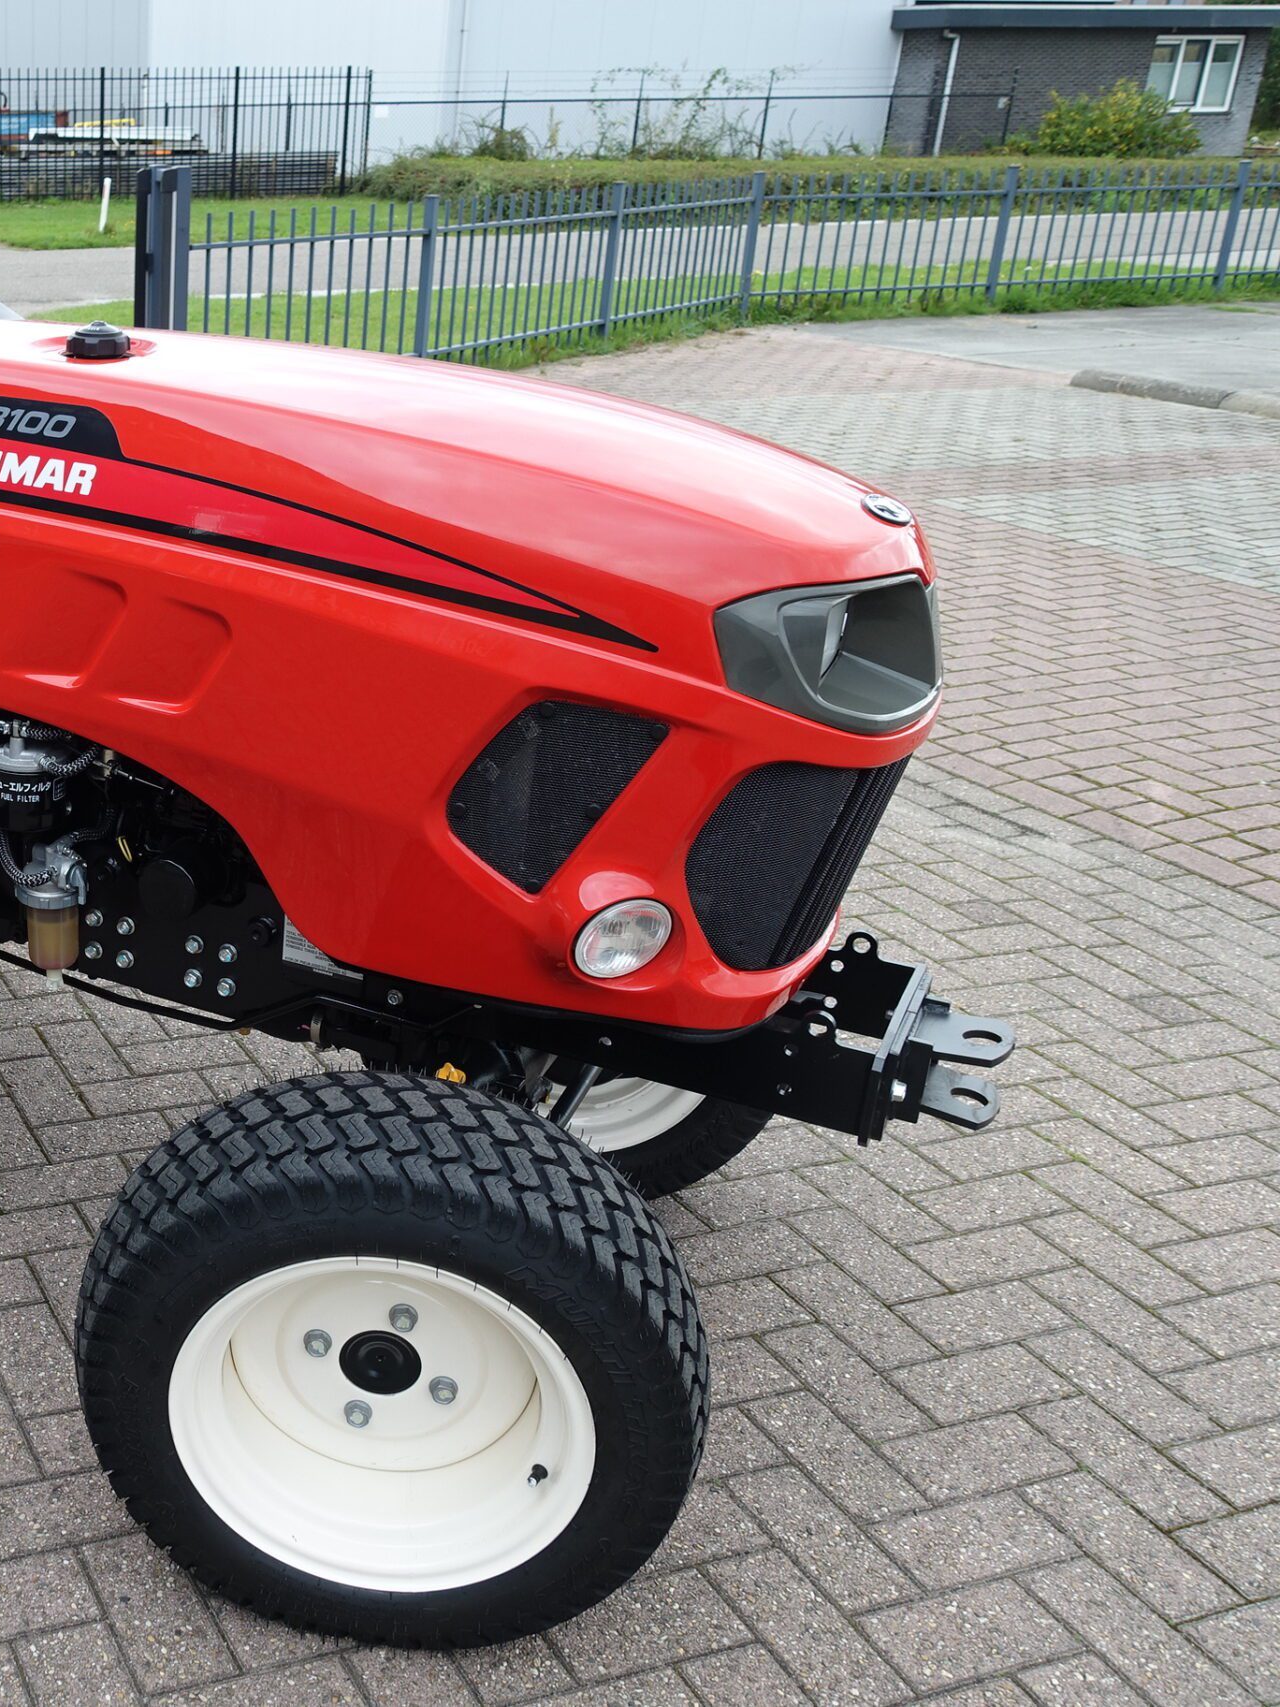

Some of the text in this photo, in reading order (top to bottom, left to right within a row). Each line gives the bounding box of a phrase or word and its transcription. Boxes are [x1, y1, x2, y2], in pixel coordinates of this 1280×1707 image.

[1, 792, 40, 803] FUEL FILTER
[504, 1264, 635, 1385] MULTI
